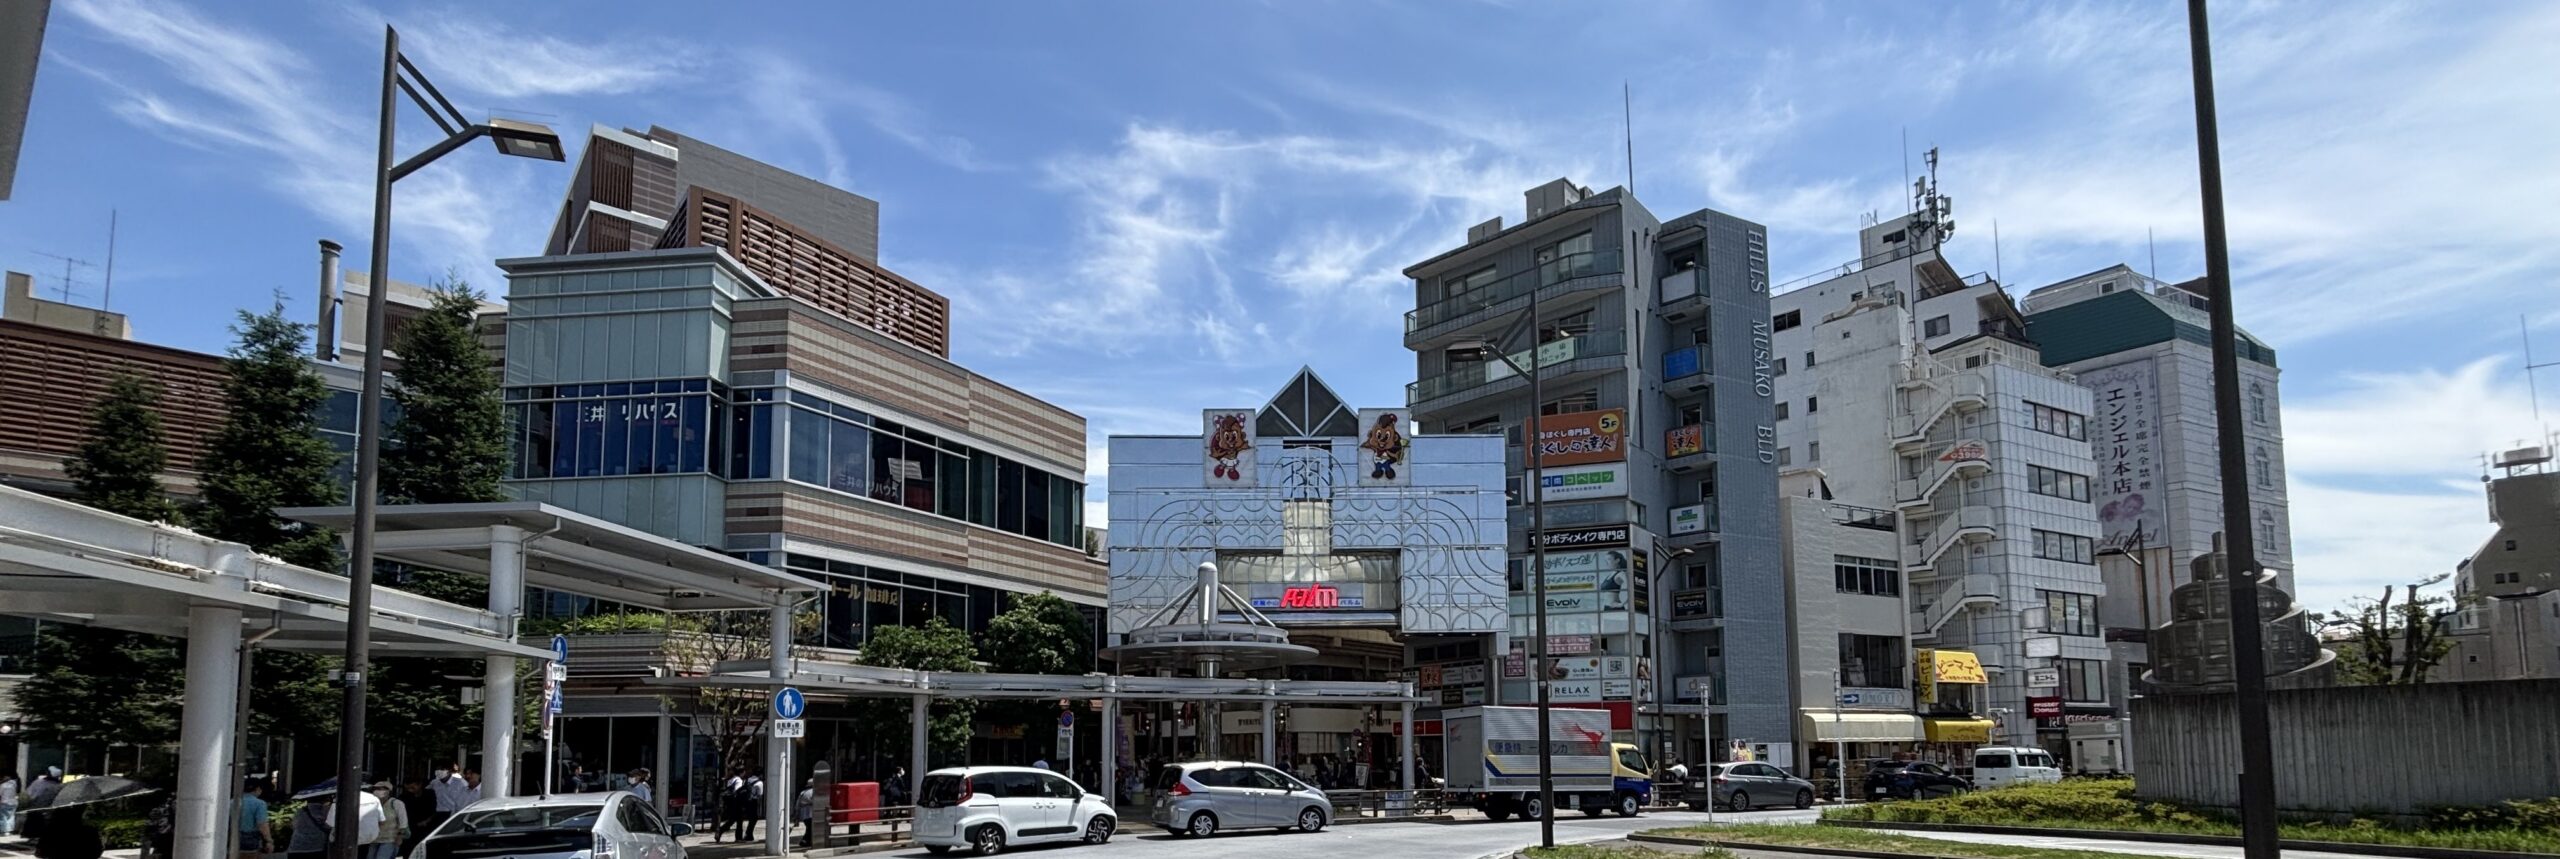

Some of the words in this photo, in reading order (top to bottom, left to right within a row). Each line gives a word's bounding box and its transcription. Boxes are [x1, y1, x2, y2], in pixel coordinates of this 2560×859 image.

[1749, 230, 1765, 293] HILLS
[1753, 319, 1772, 397] MUSAKO
[1601, 417, 1617, 429] 5F
[2107, 387, 2132, 495] エンジェル本店
[1757, 424, 1773, 464] BLD
[1546, 598, 1580, 607] Evolv
[1554, 686, 1590, 694] RELAX
